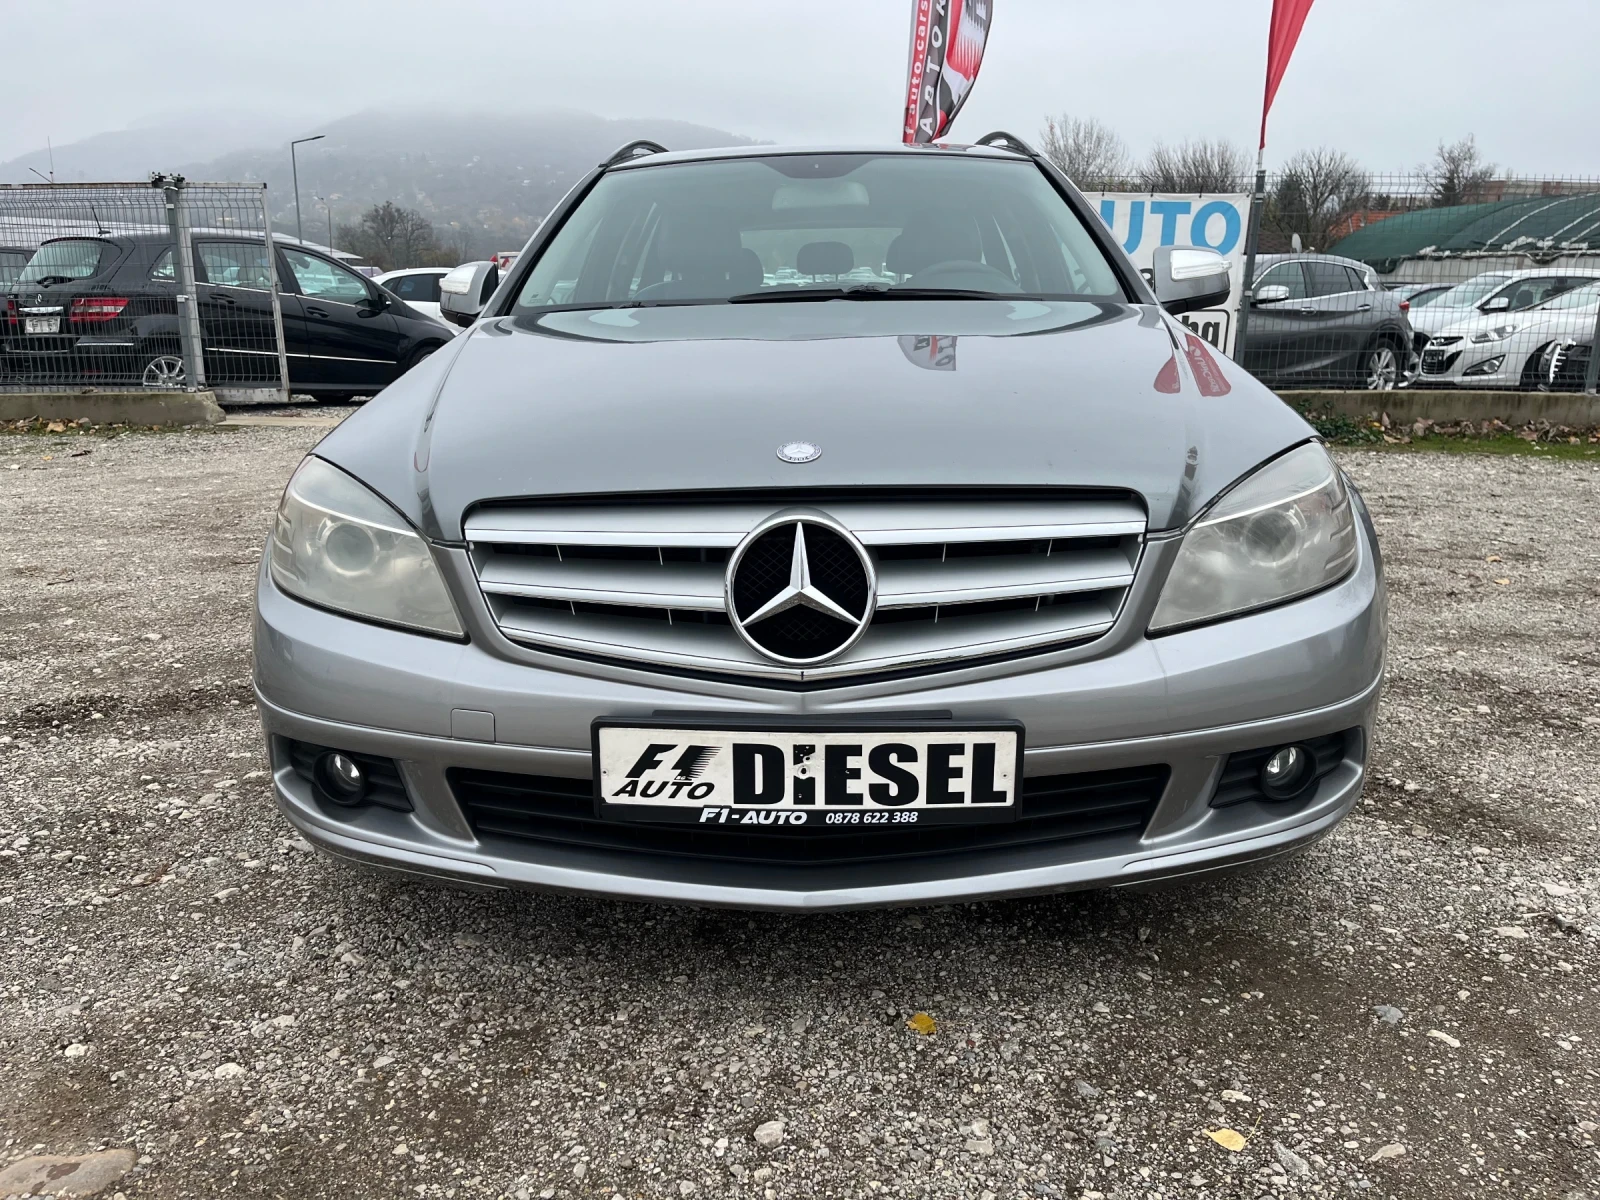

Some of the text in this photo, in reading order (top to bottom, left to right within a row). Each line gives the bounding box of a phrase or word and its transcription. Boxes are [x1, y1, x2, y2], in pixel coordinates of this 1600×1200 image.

[624, 743, 723, 781] F1
[732, 742, 1008, 807] DIESEL
[611, 779, 715, 800] AUTO
[699, 807, 919, 825] F1-AUTO 0878 622 388
